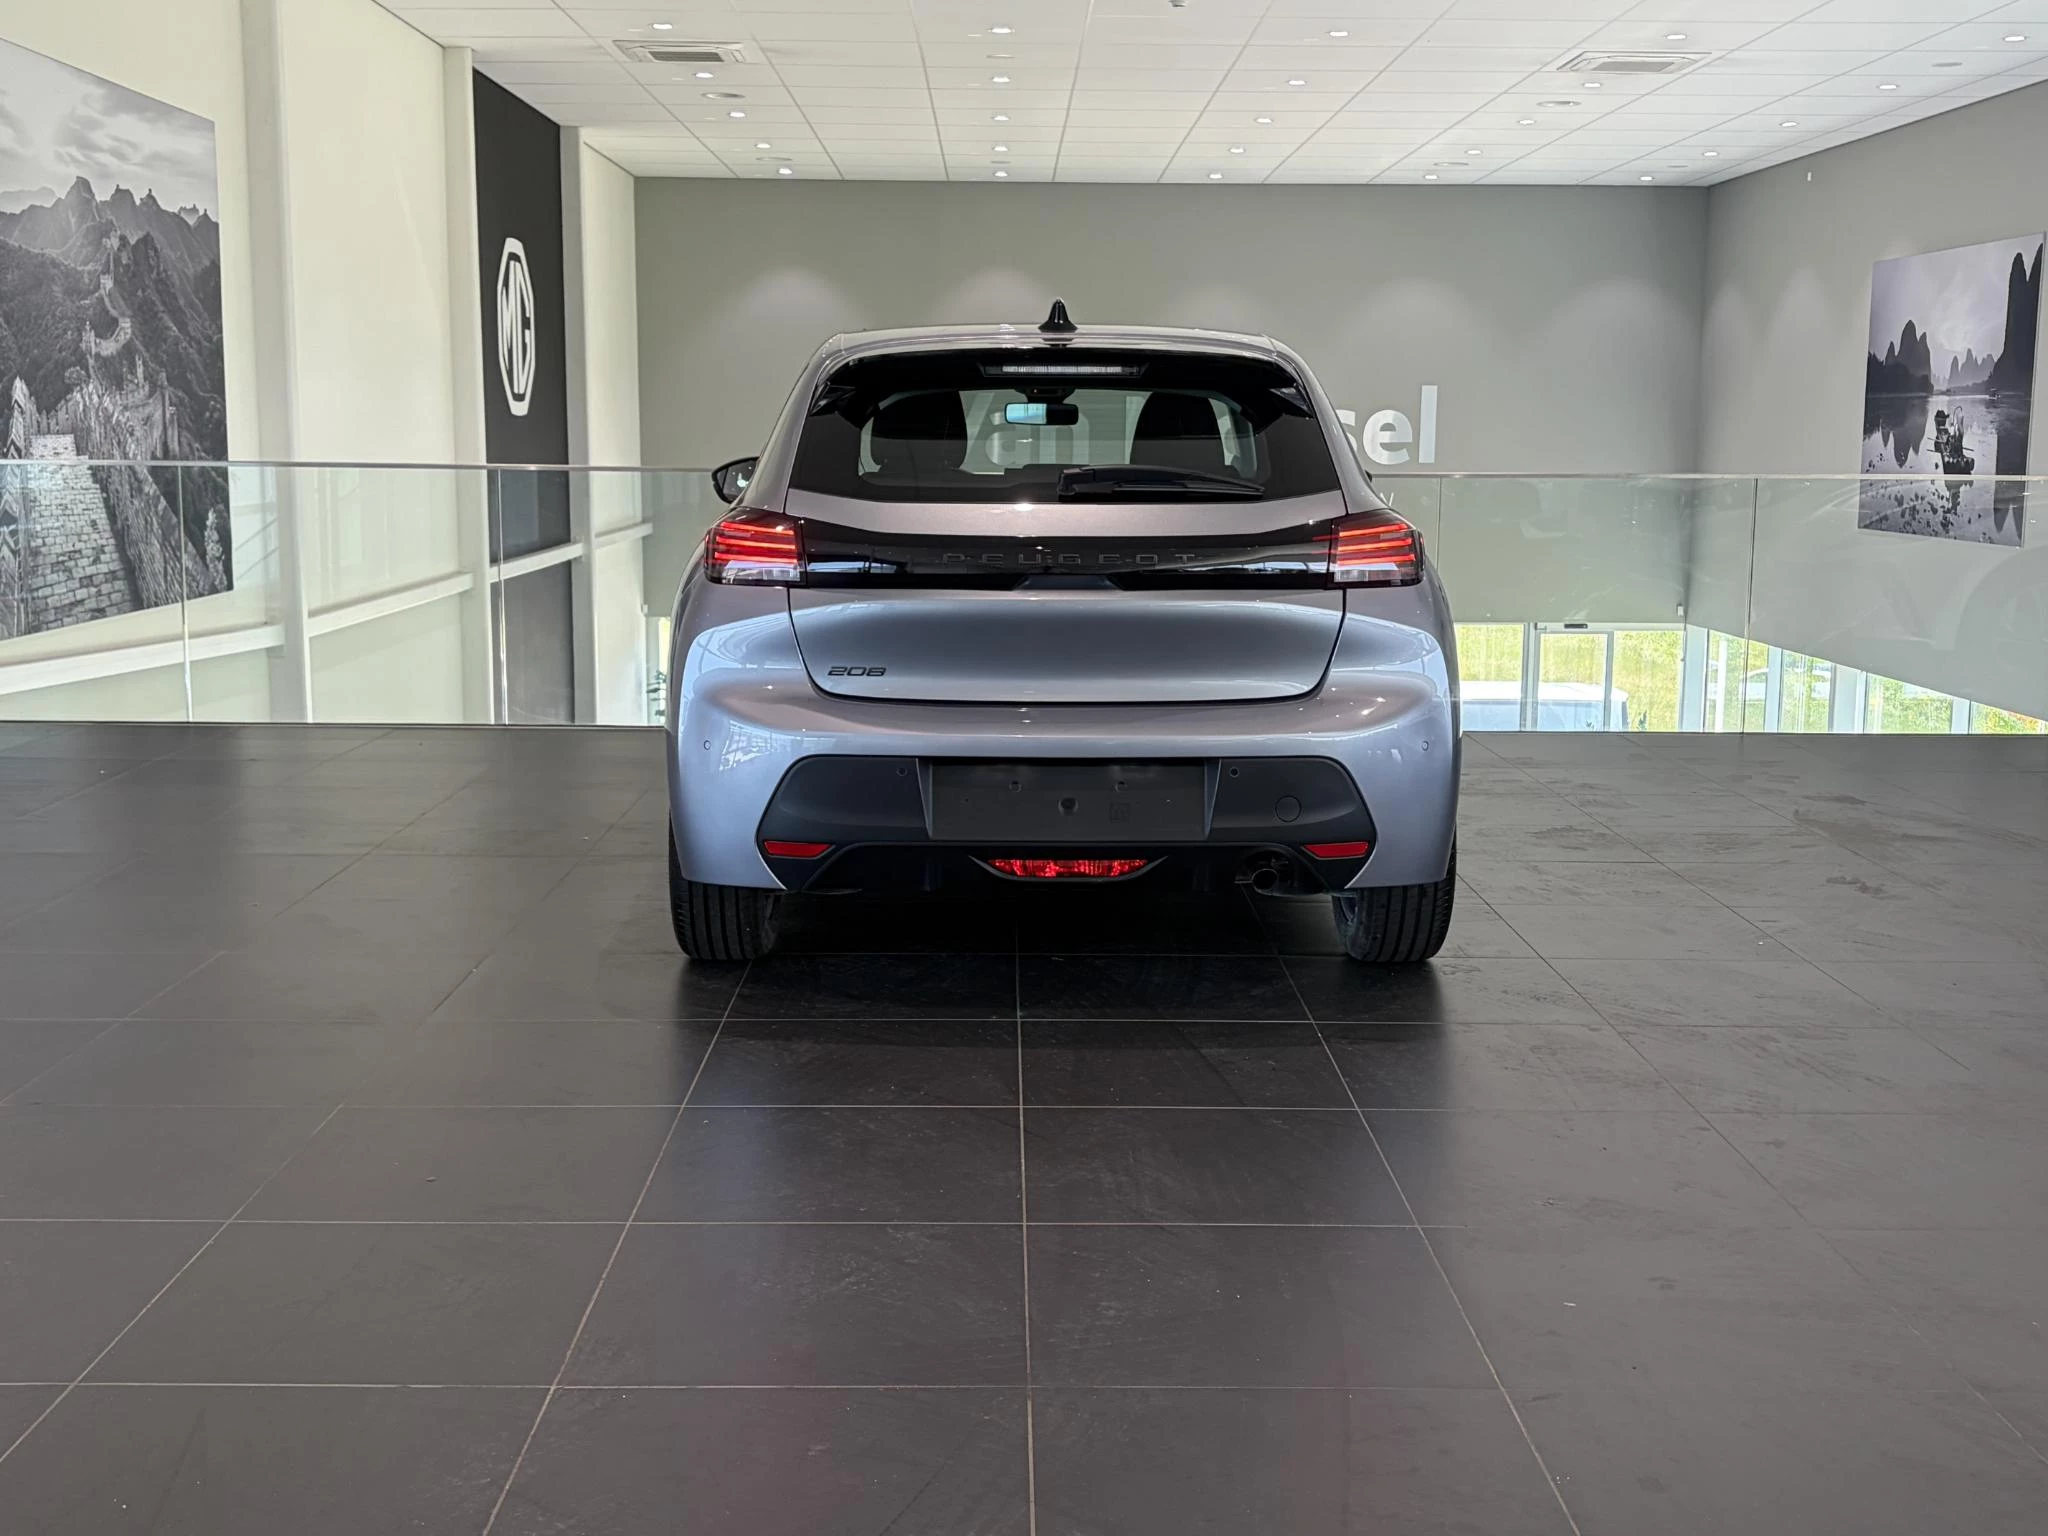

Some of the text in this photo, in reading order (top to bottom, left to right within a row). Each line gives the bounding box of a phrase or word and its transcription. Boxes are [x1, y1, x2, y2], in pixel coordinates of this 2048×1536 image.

[501, 258, 532, 395] MG
[942, 553, 1196, 565] PEUGEOT
[827, 666, 887, 677] 208
